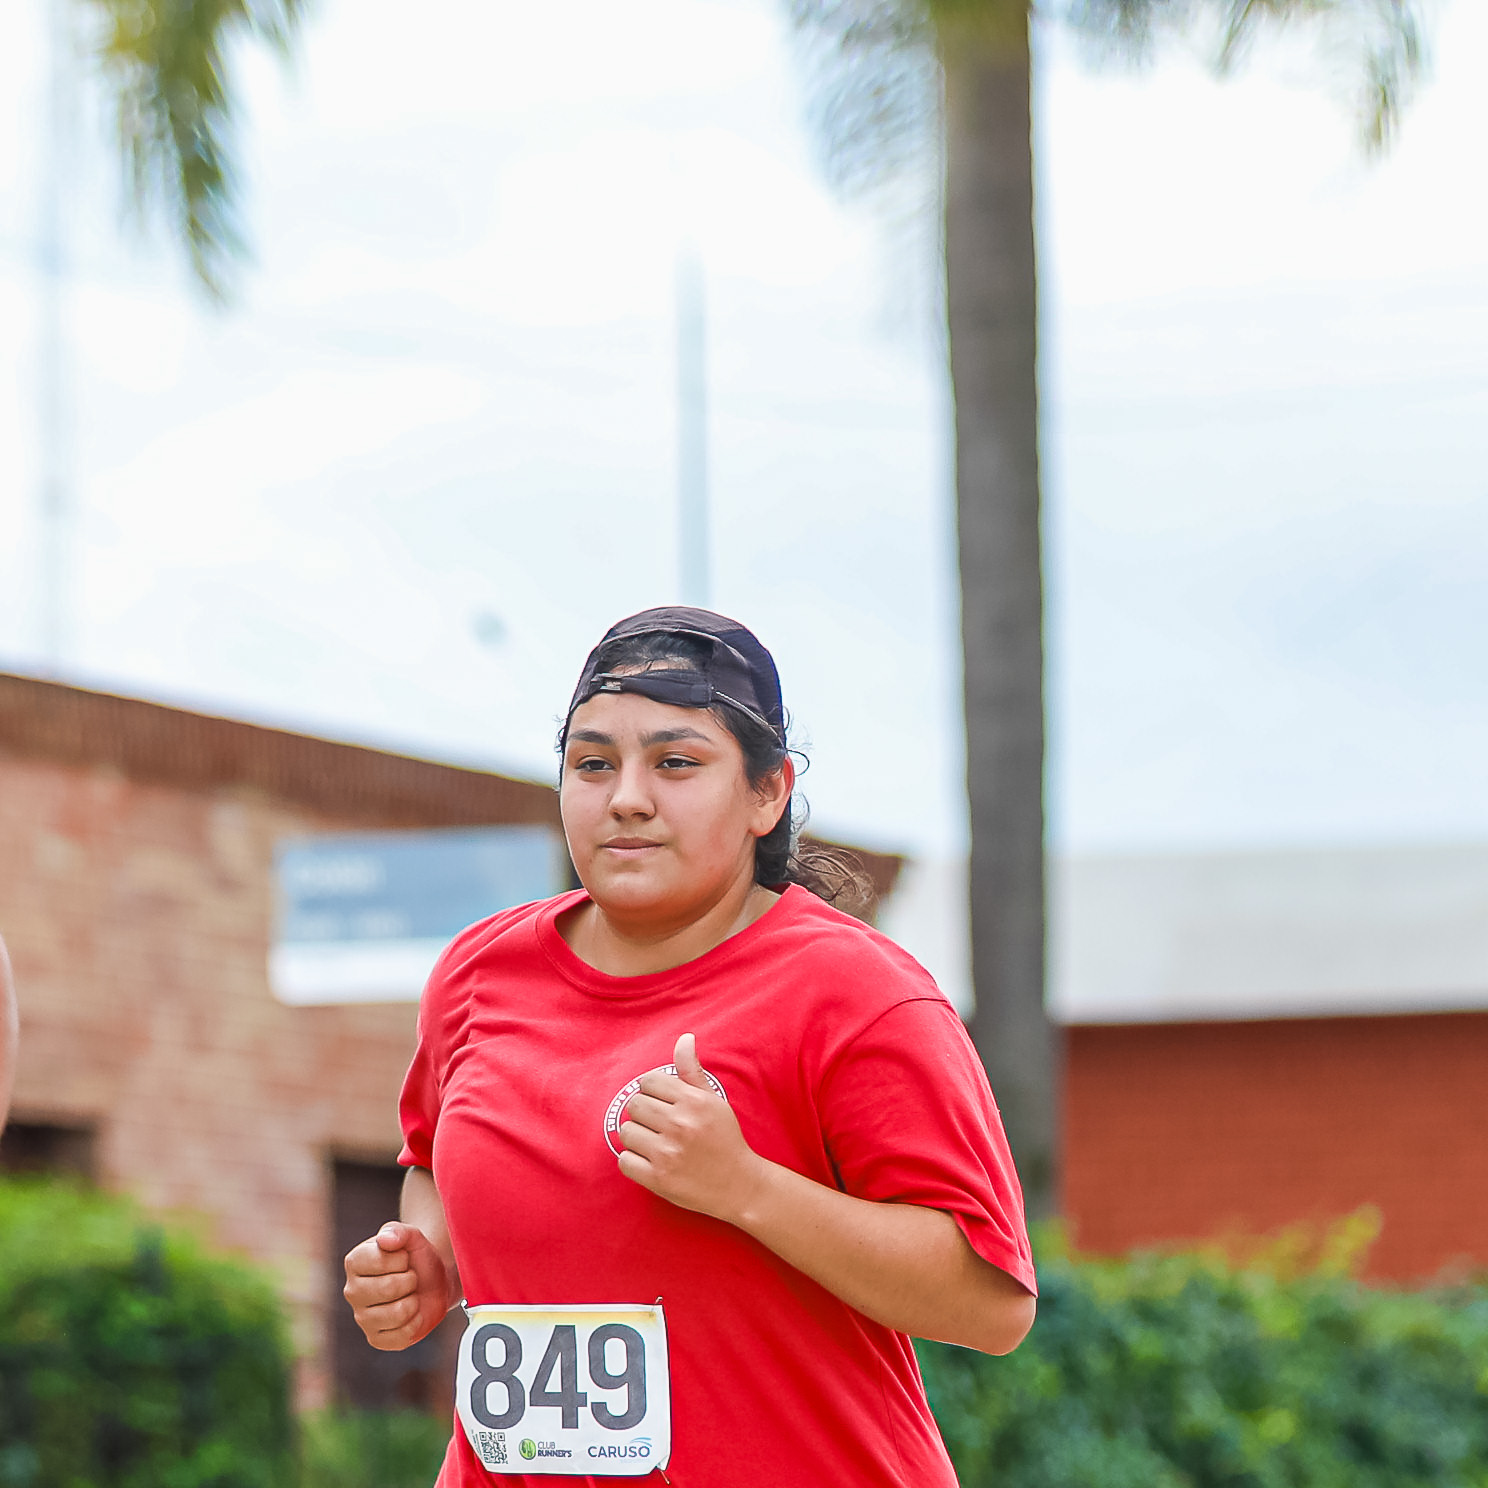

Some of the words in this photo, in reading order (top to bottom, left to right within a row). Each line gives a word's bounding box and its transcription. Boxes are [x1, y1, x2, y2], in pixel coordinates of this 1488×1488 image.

[607, 1094, 627, 1132] CUERPO
[470, 1323, 648, 1431] 849
[537, 1441, 556, 1450] CLUB
[588, 1445, 651, 1458] CARUSO
